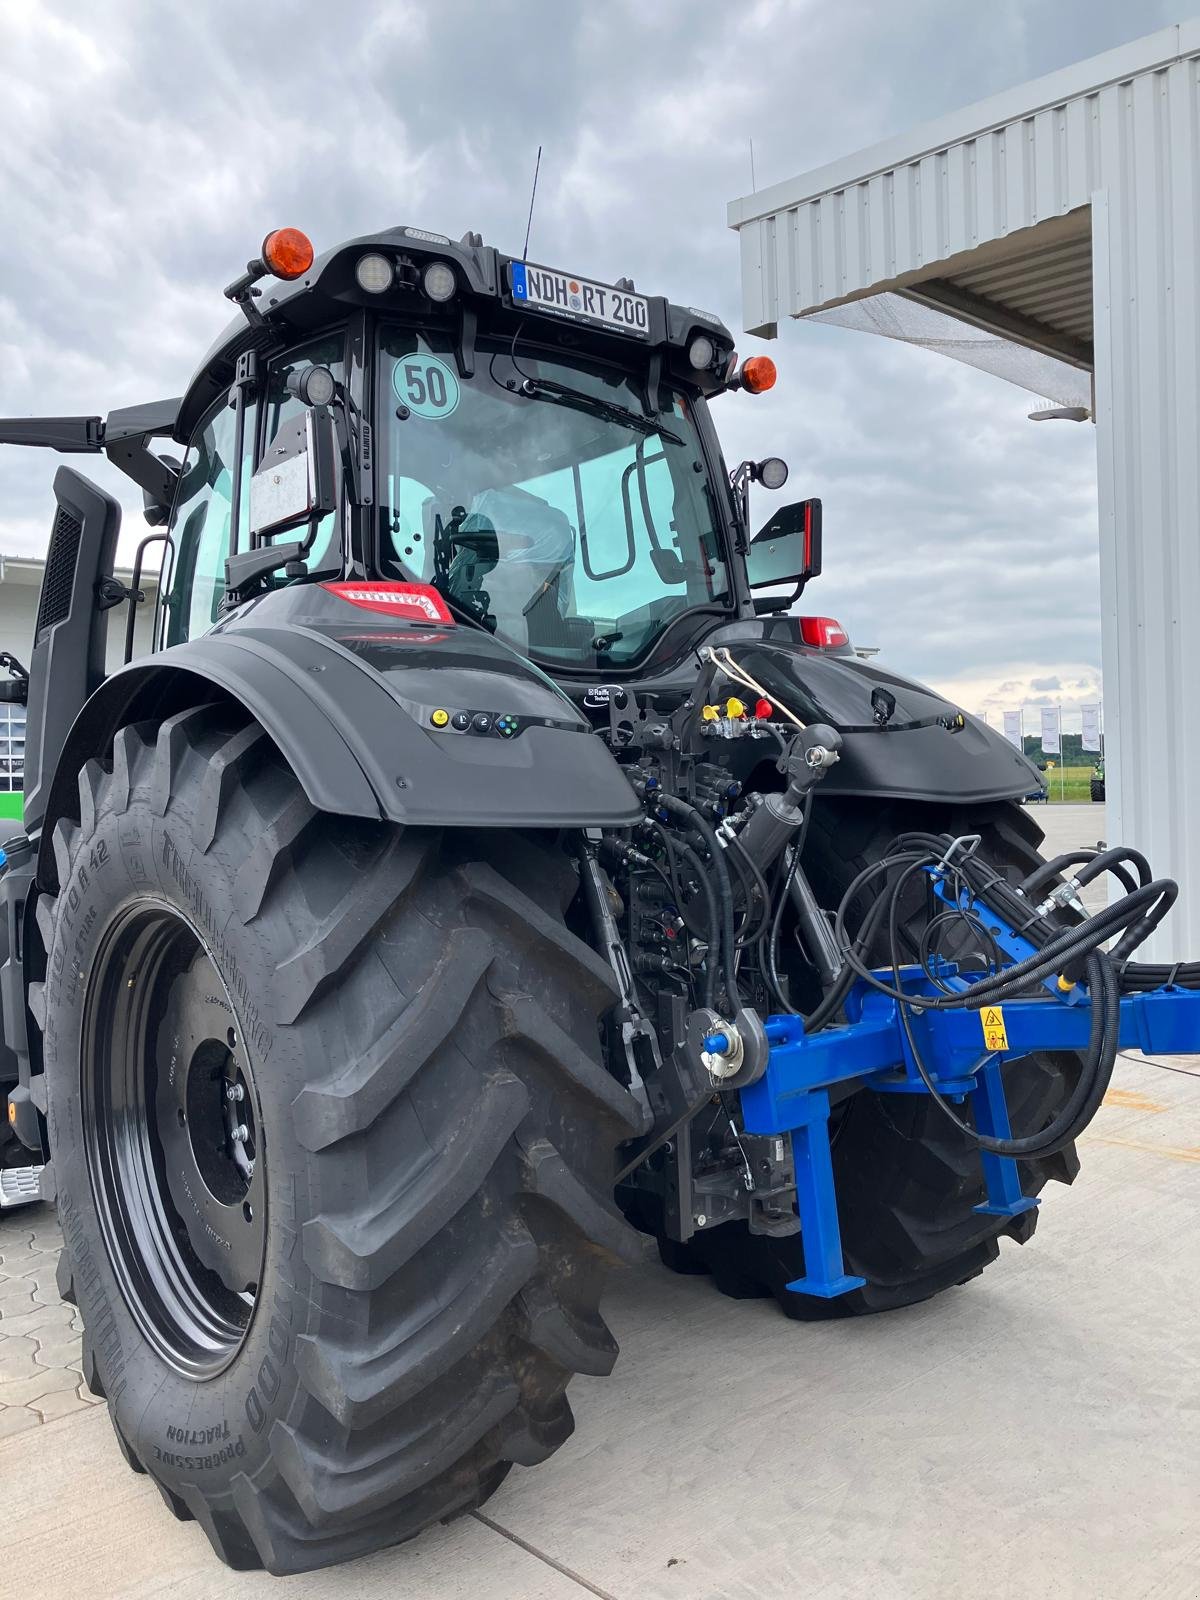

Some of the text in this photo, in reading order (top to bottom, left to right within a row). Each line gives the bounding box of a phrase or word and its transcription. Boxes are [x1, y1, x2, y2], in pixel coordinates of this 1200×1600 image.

[527, 269, 646, 328] NDH RT 200
[404, 364, 447, 408] 50
[363, 425, 371, 460] UNLIMITED
[89, 839, 110, 873] 42
[166, 1420, 232, 1447] TRACTION
[153, 1435, 247, 1471] PROGRESSIVE
